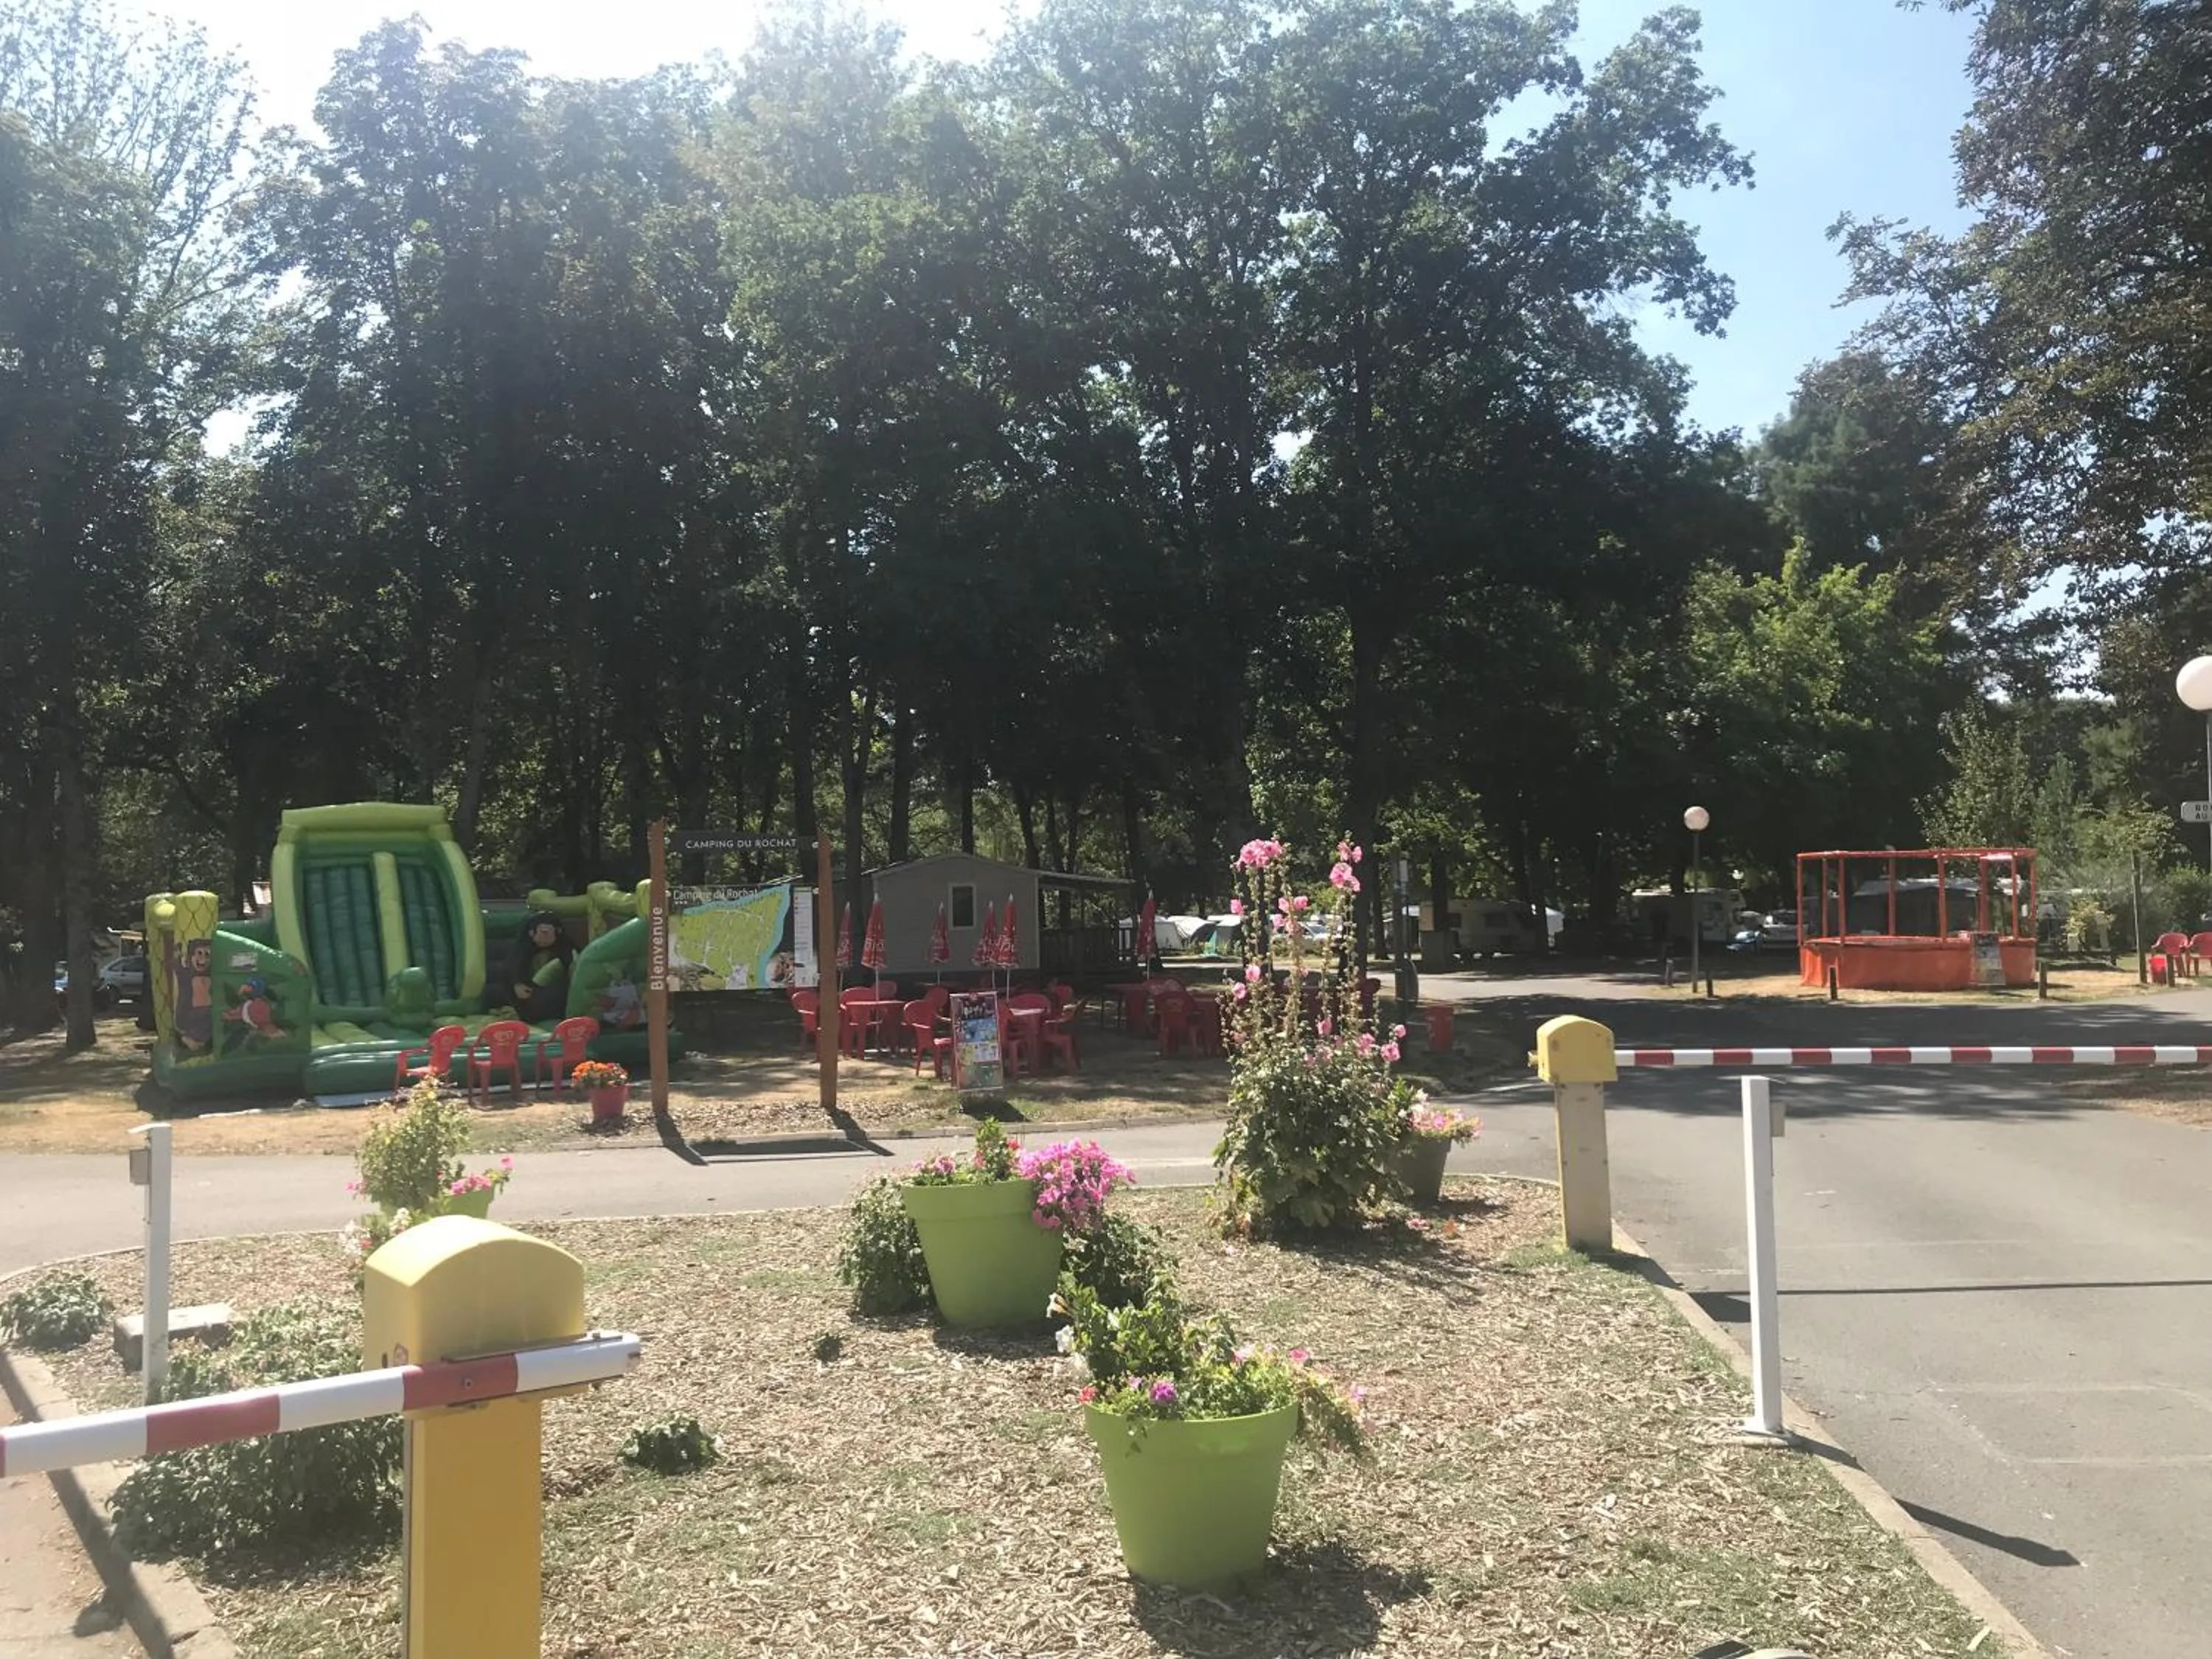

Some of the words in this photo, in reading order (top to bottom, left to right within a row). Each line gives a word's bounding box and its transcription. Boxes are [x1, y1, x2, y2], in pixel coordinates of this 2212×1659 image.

[685, 839, 734, 849] CAMPING
[737, 839, 751, 848] DU
[754, 838, 796, 847] ROCHAT
[673, 890, 712, 902] Camping
[713, 889, 725, 899] du
[726, 888, 758, 899] Rochat
[650, 906, 664, 990] Bienvenue
